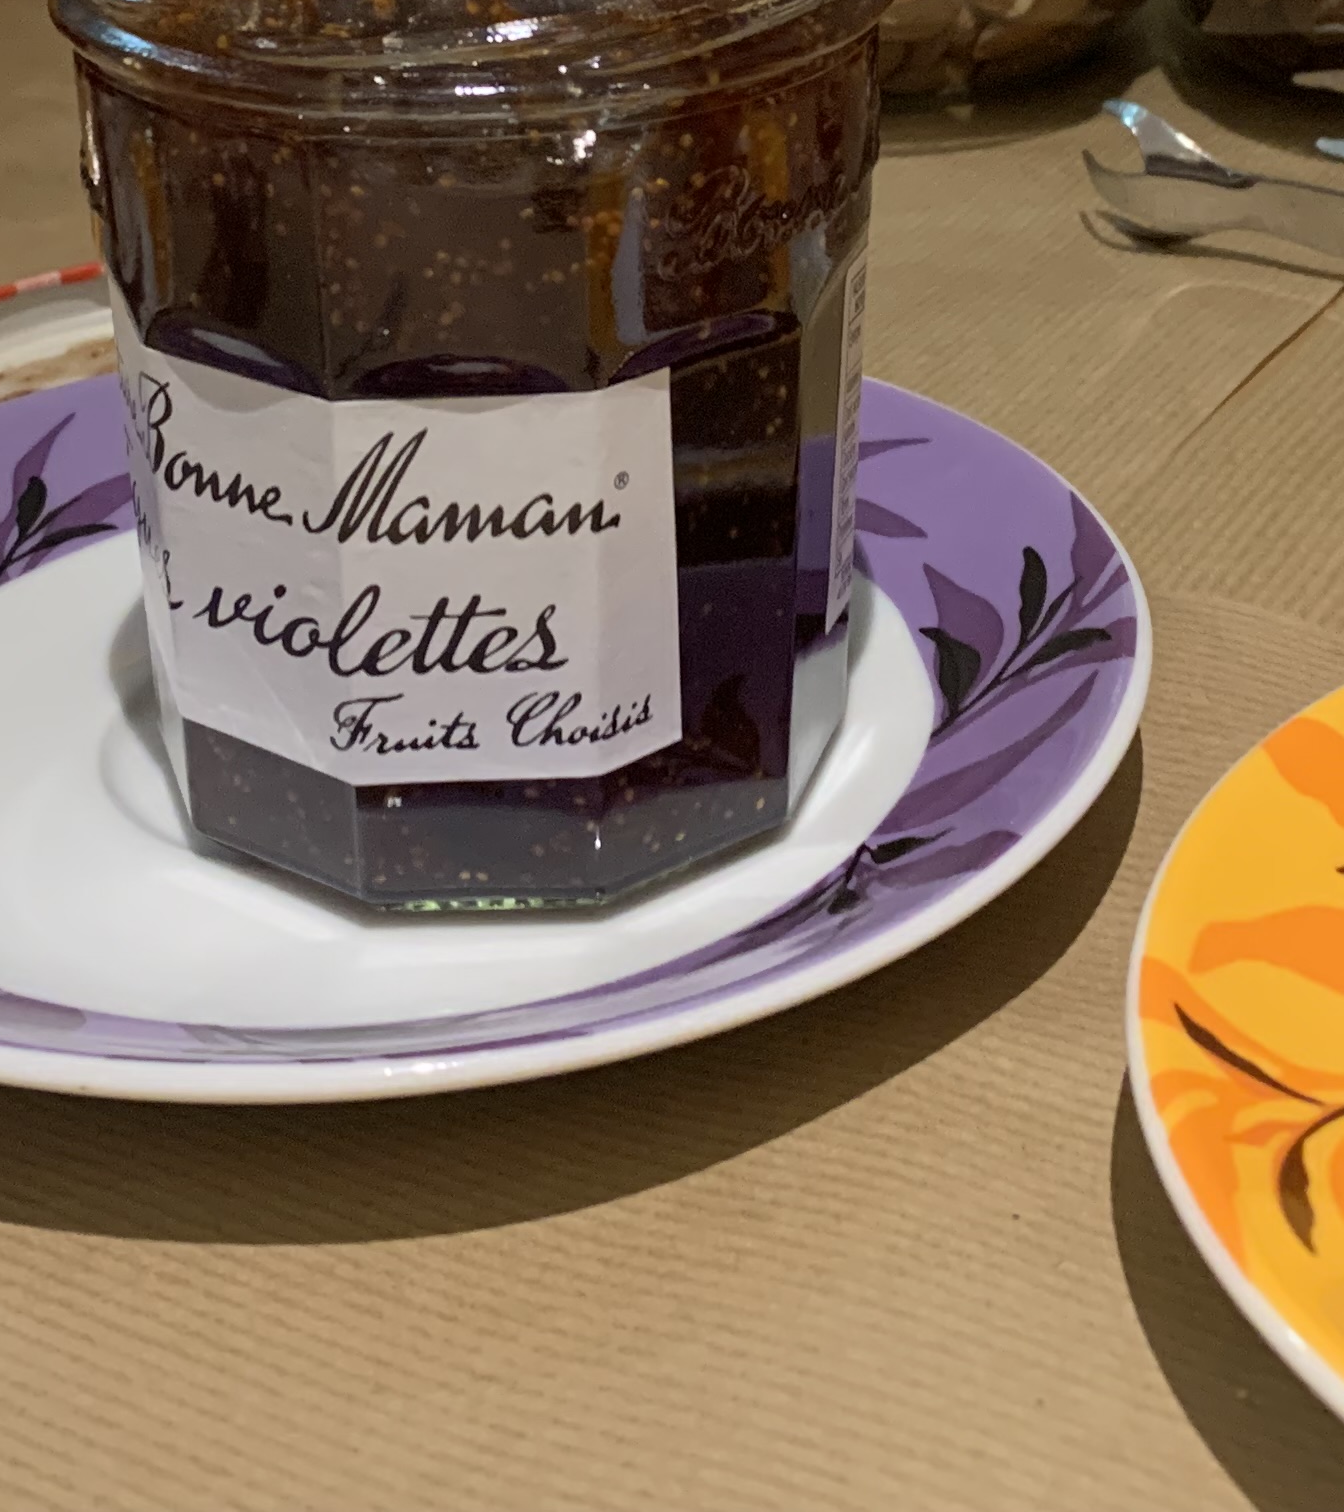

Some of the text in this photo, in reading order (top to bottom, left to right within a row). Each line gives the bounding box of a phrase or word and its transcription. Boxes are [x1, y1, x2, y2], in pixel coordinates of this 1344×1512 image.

[138, 370, 293, 527] Bonne
[192, 584, 569, 678] violettes
[329, 690, 655, 756] Fruits Choisis
